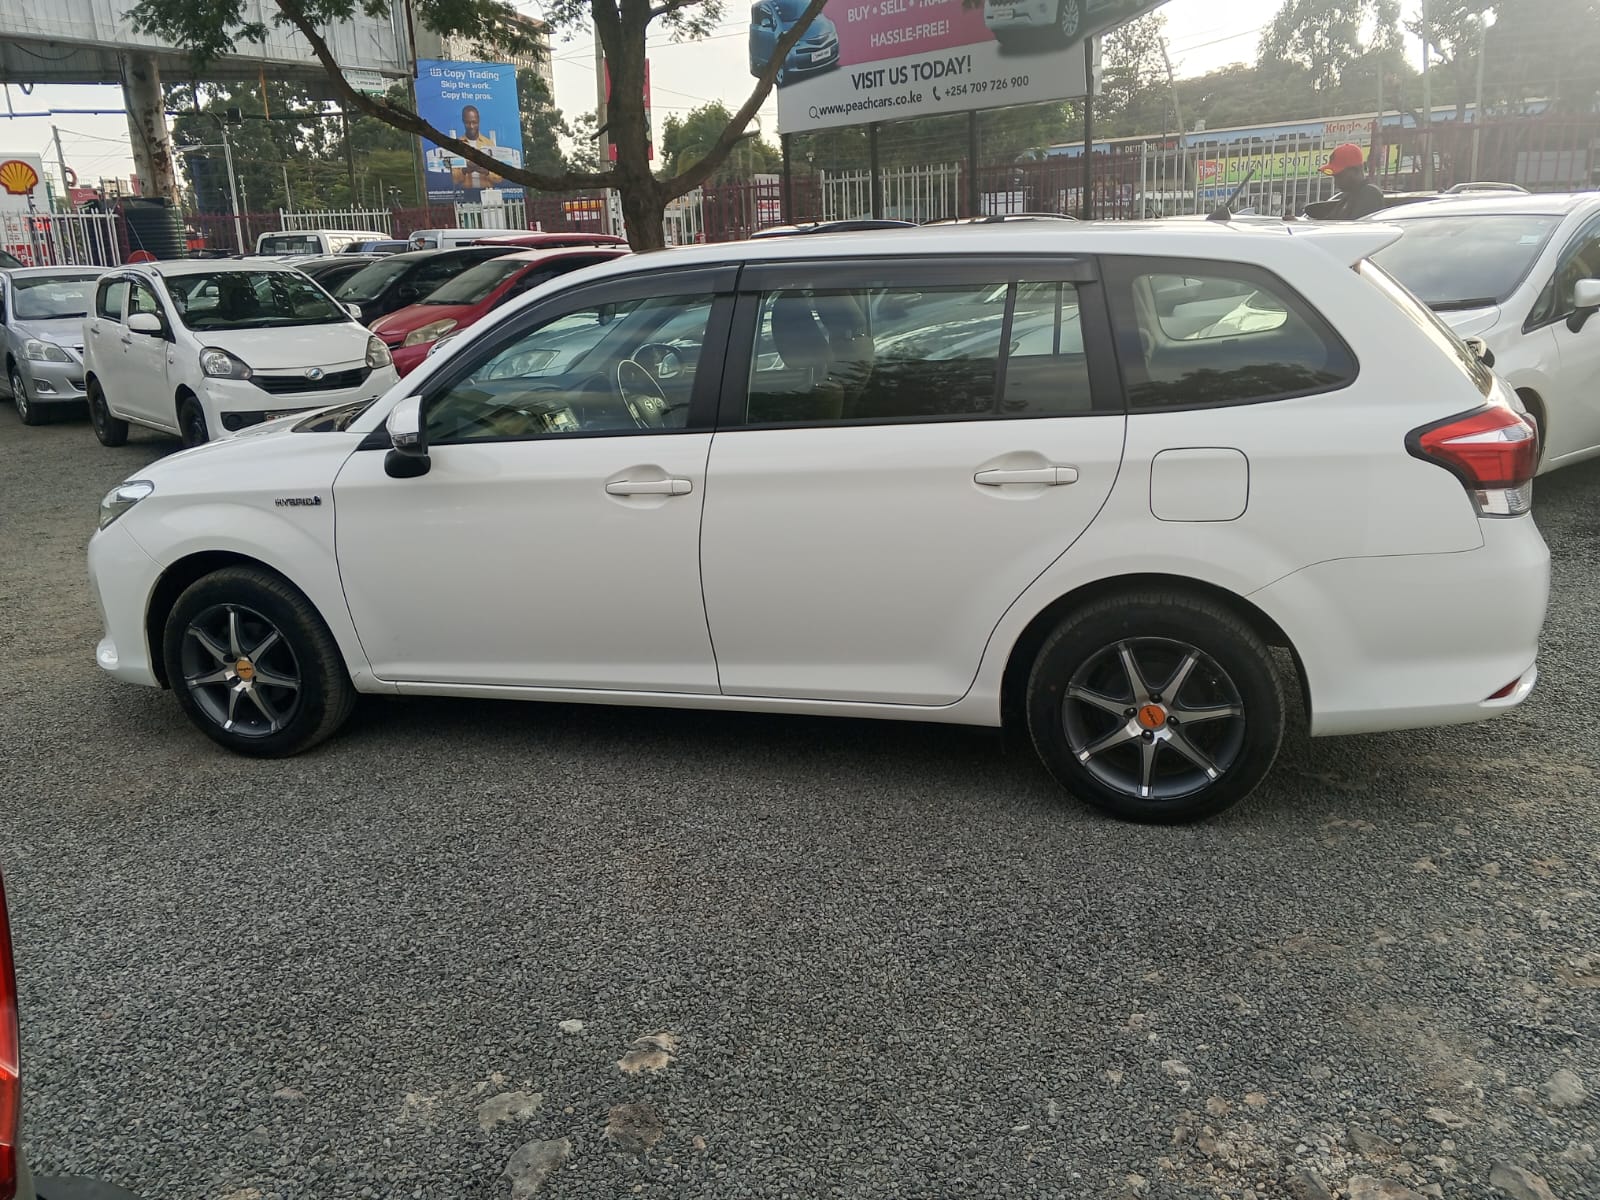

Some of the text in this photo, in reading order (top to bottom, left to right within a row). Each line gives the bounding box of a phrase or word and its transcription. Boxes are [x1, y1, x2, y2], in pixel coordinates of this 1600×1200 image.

[847, 5, 870, 22] BUY
[880, 0, 907, 15] SELL
[870, 19, 950, 48] HASSLE-FREE!
[443, 68, 499, 81] Copy Trading
[851, 54, 971, 91] VISIT US TODAY!
[441, 80, 457, 89] Skip
[459, 81, 470, 89] the
[945, 75, 1029, 96] +254 709 726 900
[442, 91, 460, 100] Copy
[819, 90, 922, 115] www.peachcars.co.ke
